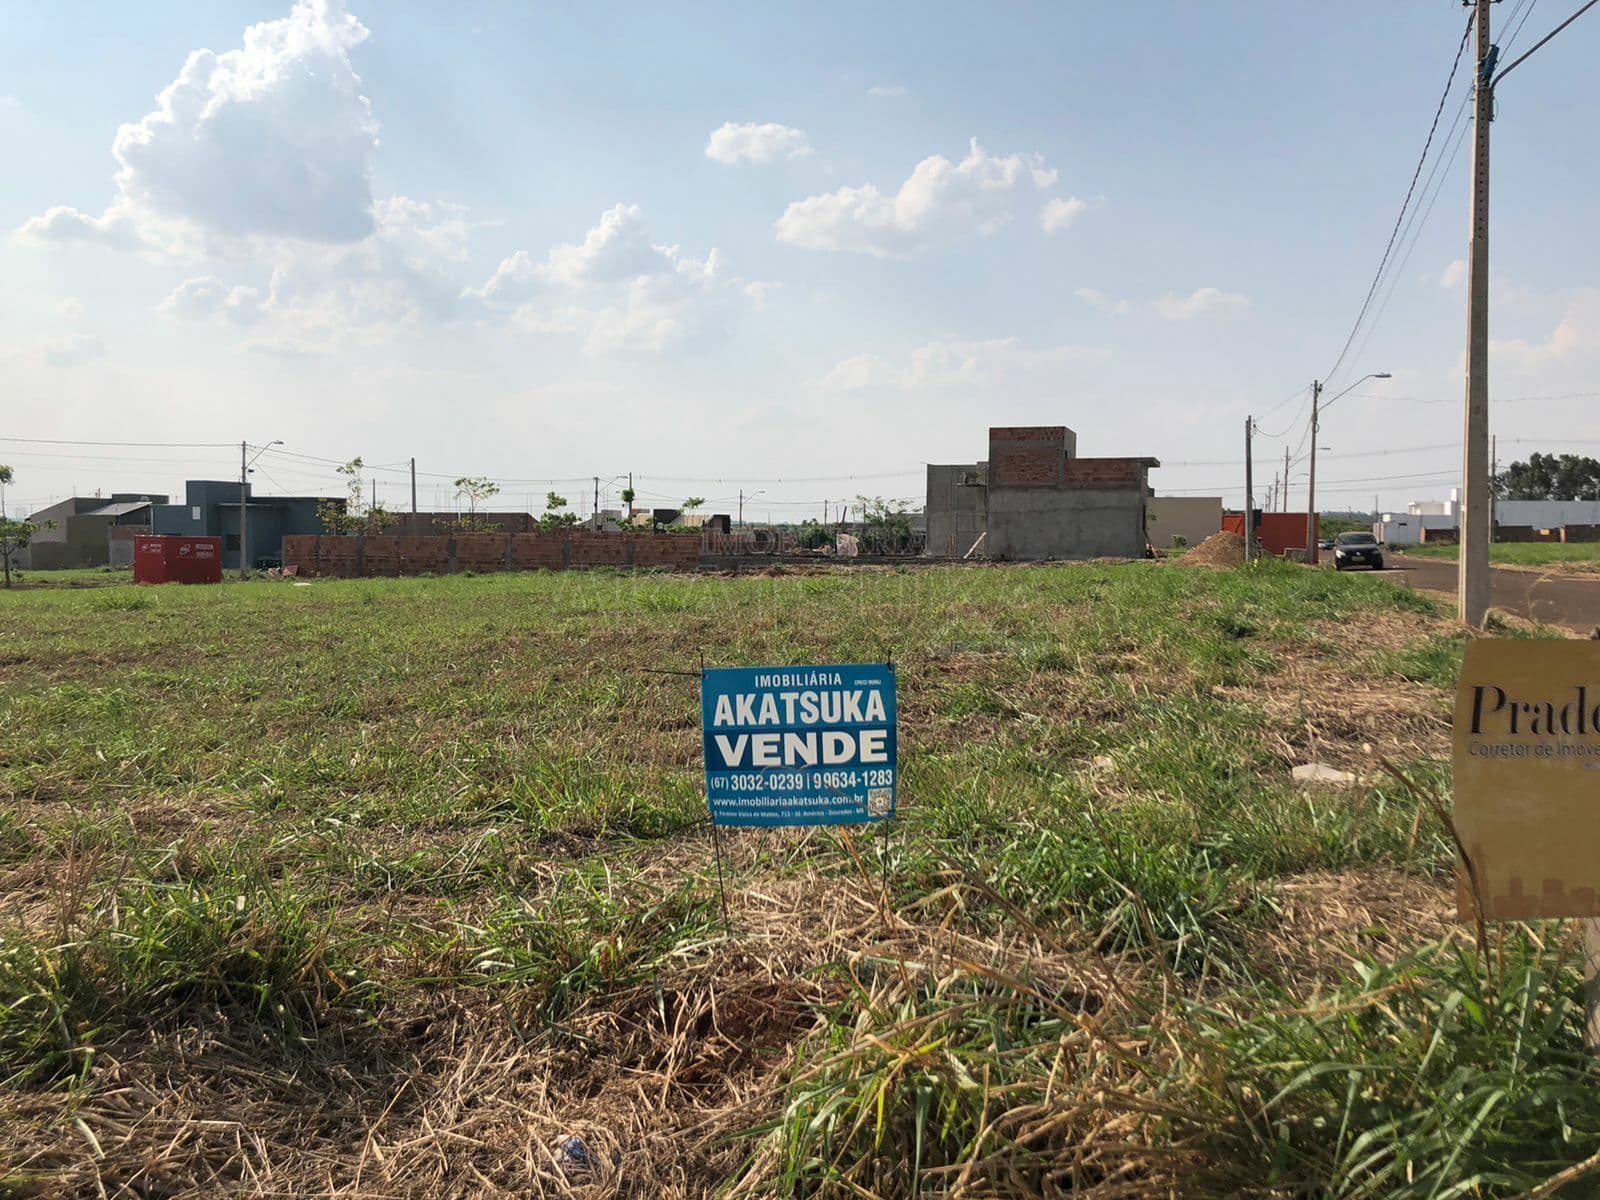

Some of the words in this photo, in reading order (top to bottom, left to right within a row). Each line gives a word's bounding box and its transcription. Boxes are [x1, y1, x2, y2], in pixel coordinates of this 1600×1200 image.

[755, 670, 842, 688] IMOBILIÁRIA
[713, 690, 887, 726] AKATSUKA
[714, 729, 888, 767] VENDE
[1470, 741, 1529, 757] Corretor
[1535, 742, 1553, 756] de
[711, 776, 729, 790] (67)
[731, 773, 803, 791] 3032-0239
